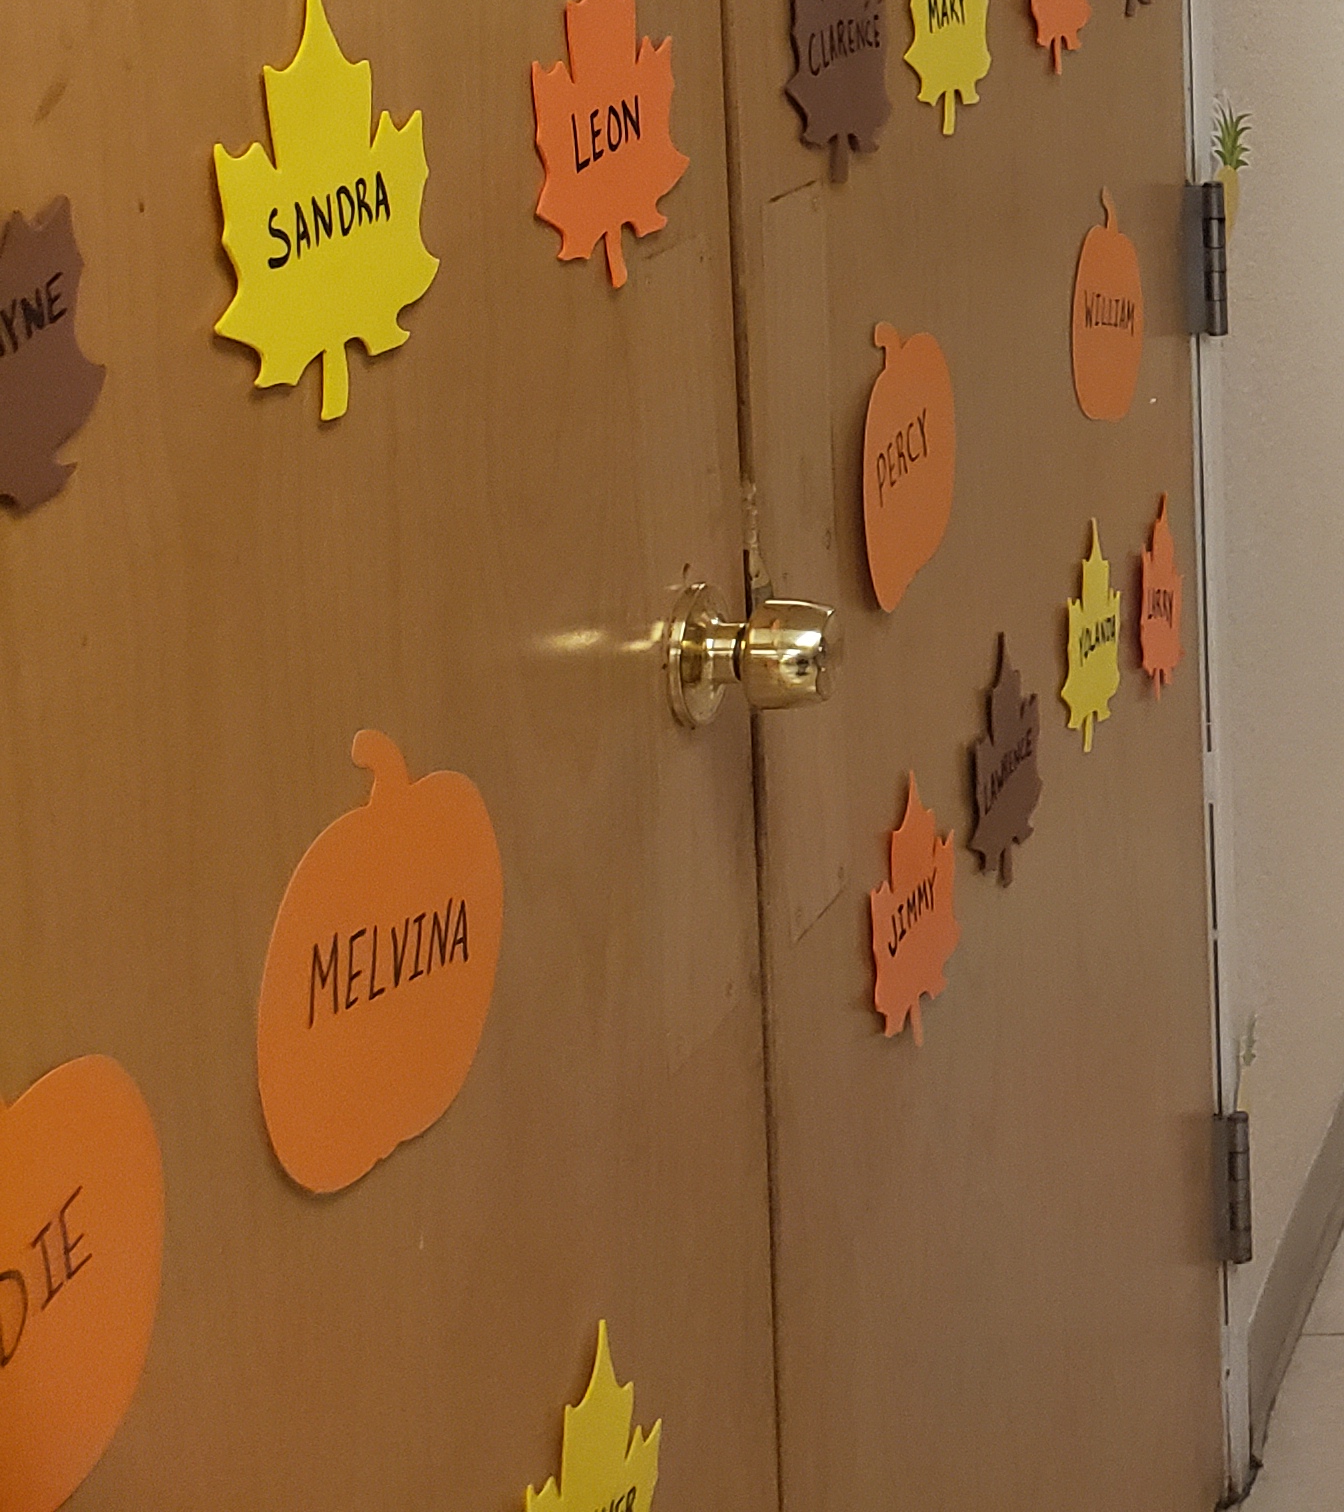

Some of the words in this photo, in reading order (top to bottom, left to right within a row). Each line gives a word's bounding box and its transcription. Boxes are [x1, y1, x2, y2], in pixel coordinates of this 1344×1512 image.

[808, 14, 880, 76] CLARENCE
[571, 94, 641, 174] LEON
[268, 171, 391, 269] SANDRA
[1084, 289, 1134, 337] WILLIAM
[877, 408, 928, 508] PERCY
[888, 867, 937, 958] JIMMY
[308, 898, 470, 1029] MELVINA
